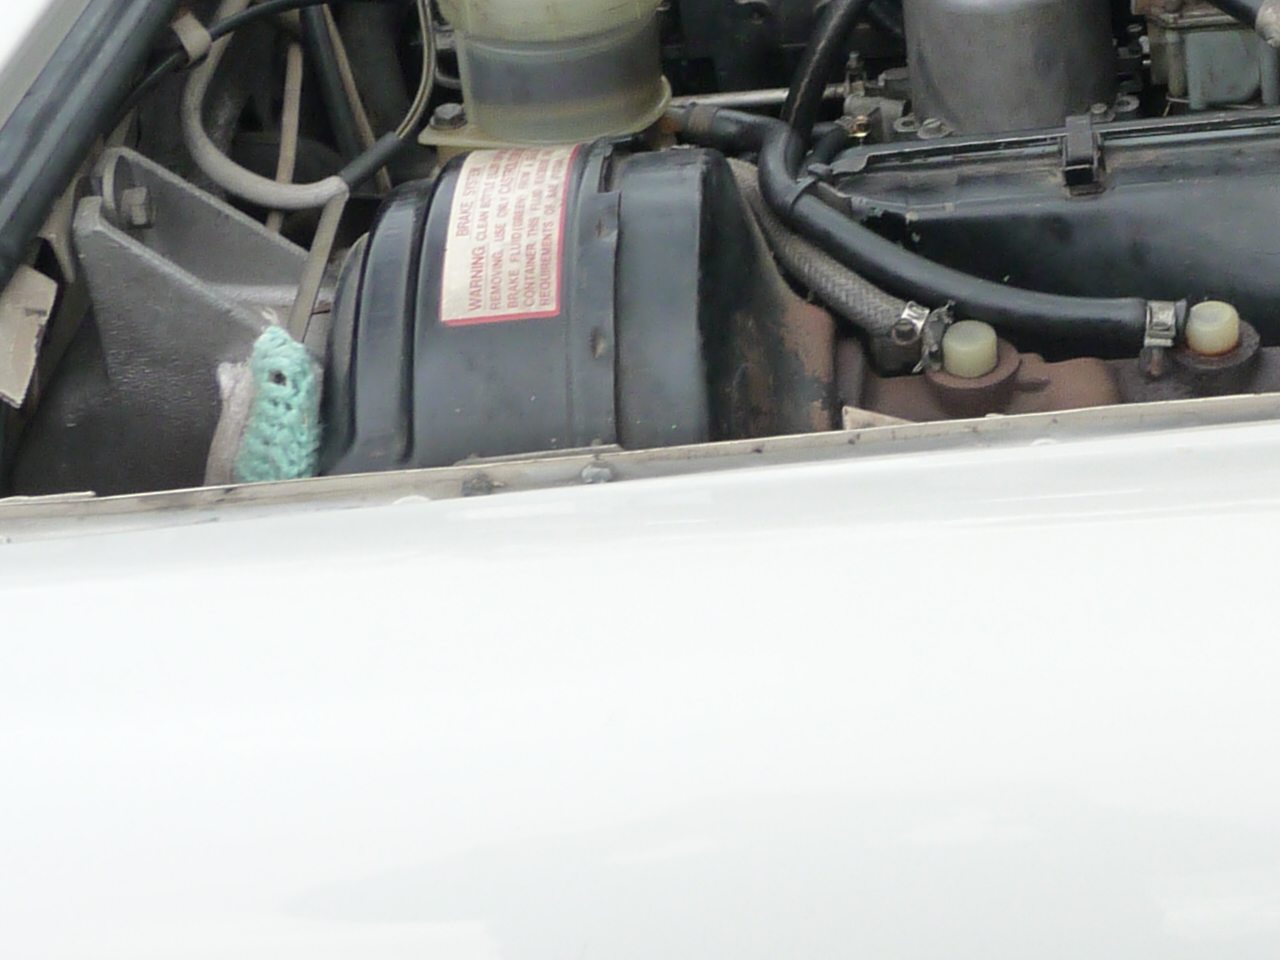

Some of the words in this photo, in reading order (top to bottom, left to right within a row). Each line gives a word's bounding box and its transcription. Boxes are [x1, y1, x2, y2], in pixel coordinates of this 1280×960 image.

[479, 182, 495, 208] BOTTLE
[496, 196, 509, 218] ONLY
[457, 203, 471, 236] BRAKE
[543, 204, 554, 215] OF
[475, 211, 489, 241] CLEAN
[494, 223, 507, 242] USE
[527, 217, 540, 237] THIS
[509, 233, 522, 262] FLUID
[539, 222, 554, 306] REQUIREMENTS
[507, 269, 520, 308] BRAKE
